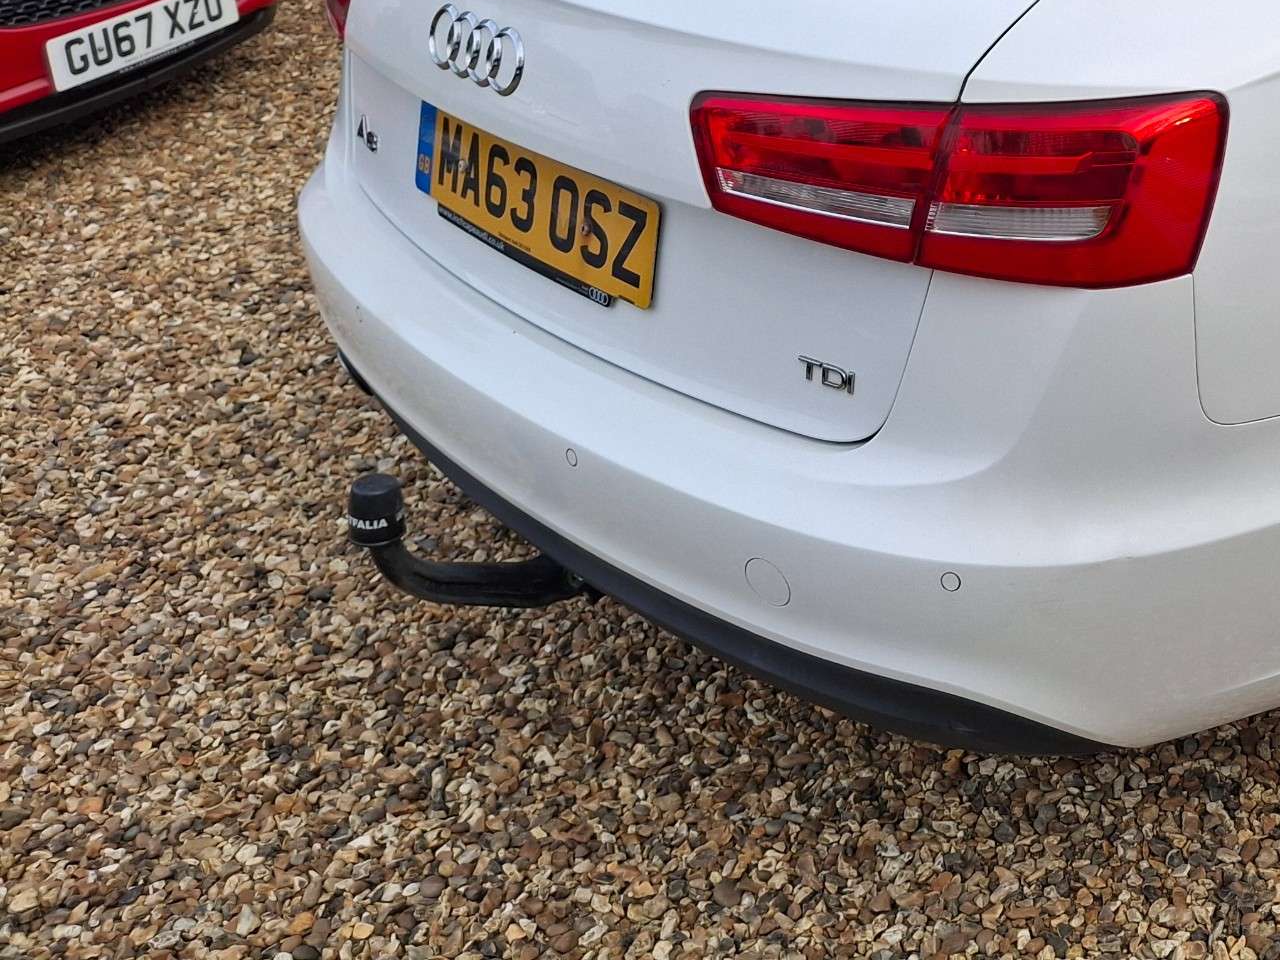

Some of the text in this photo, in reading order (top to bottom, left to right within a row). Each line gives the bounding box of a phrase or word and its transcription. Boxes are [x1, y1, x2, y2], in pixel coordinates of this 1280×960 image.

[64, 11, 153, 76] GU67
[356, 114, 378, 153] A6
[438, 116, 649, 289] MA63 OSZ
[798, 354, 856, 396] TDI
